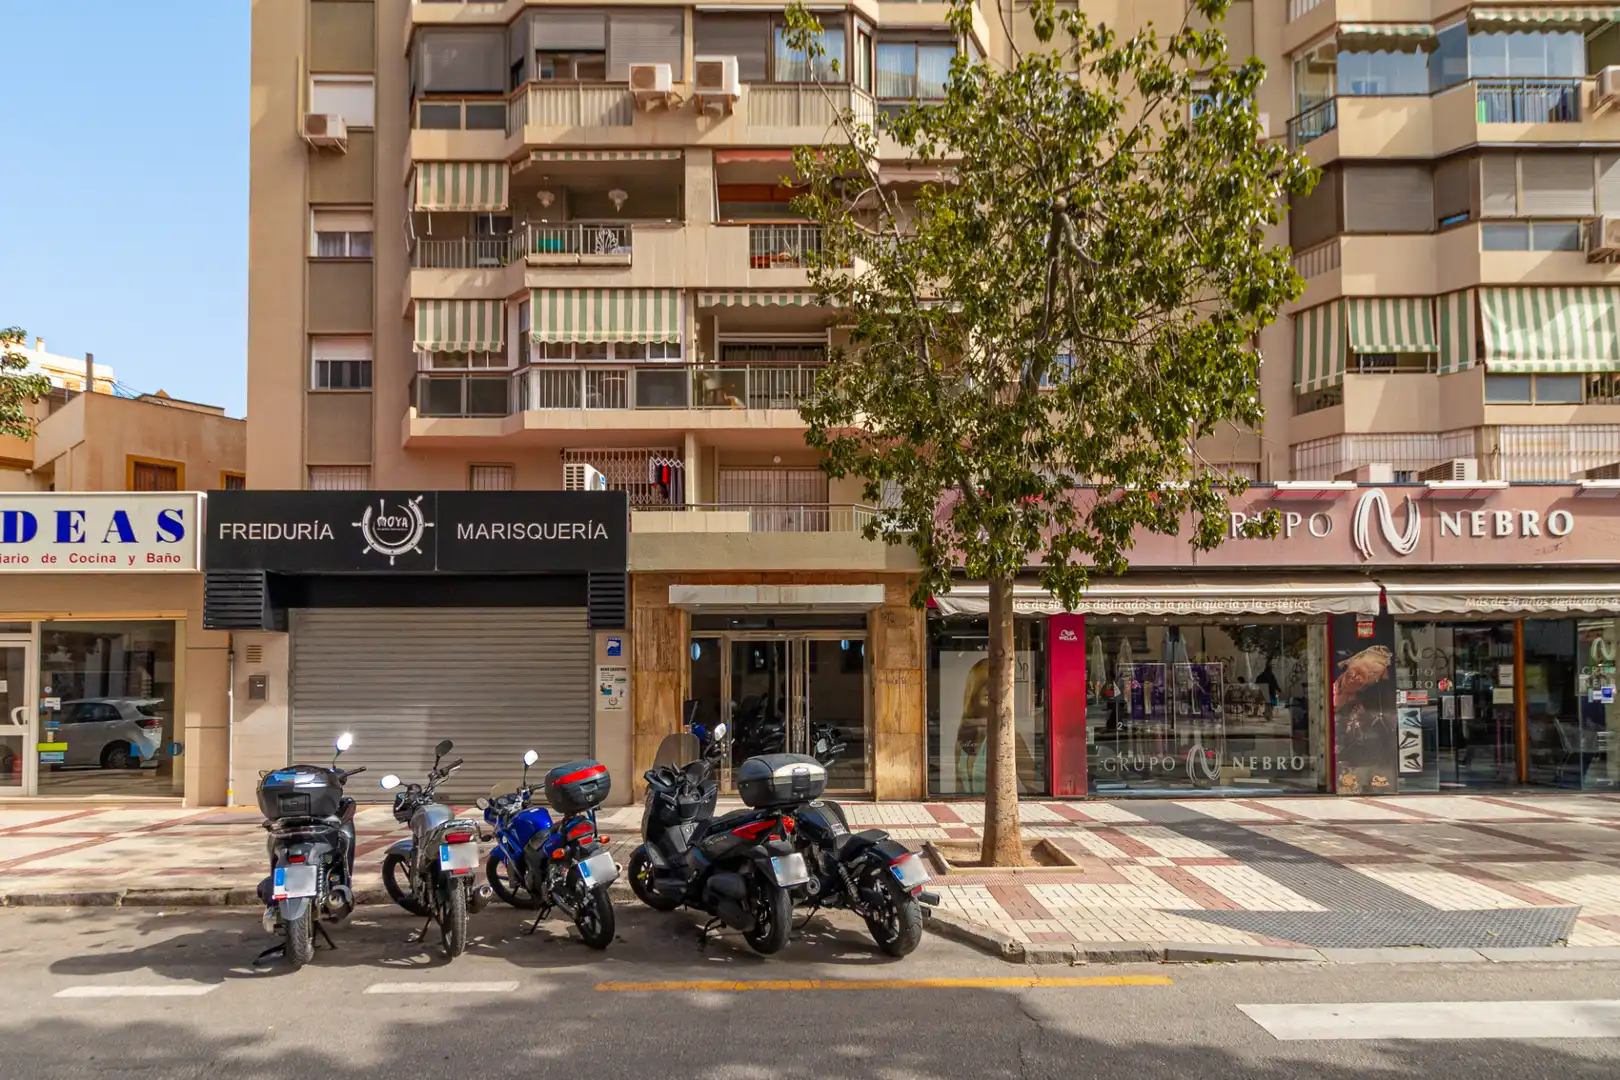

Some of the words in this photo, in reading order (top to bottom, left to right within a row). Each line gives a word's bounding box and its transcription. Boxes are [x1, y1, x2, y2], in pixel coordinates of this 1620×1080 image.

[219, 520, 335, 540] FREIDURÍA
[377, 516, 408, 528] MOYA
[457, 520, 608, 540] MARISQUERÍA
[1202, 511, 1332, 540] RPO
[1439, 510, 1574, 537] NEBRO
[41, 553, 57, 564] de
[69, 553, 117, 564] Cocina
[128, 555, 136, 565] y
[146, 552, 181, 563] Baño
[1013, 600, 1029, 609] ás
[1032, 599, 1045, 609] de
[1048, 600, 1060, 609] 50
[1091, 598, 1151, 609] dedicados
[1154, 601, 1161, 609] a
[1164, 598, 1174, 609] la
[1177, 598, 1239, 611] peluquería
[1252, 598, 1263, 609] la
[1265, 598, 1310, 609] estética
[1104, 756, 1176, 772] GRUPO
[1232, 756, 1305, 771] NEBRO
